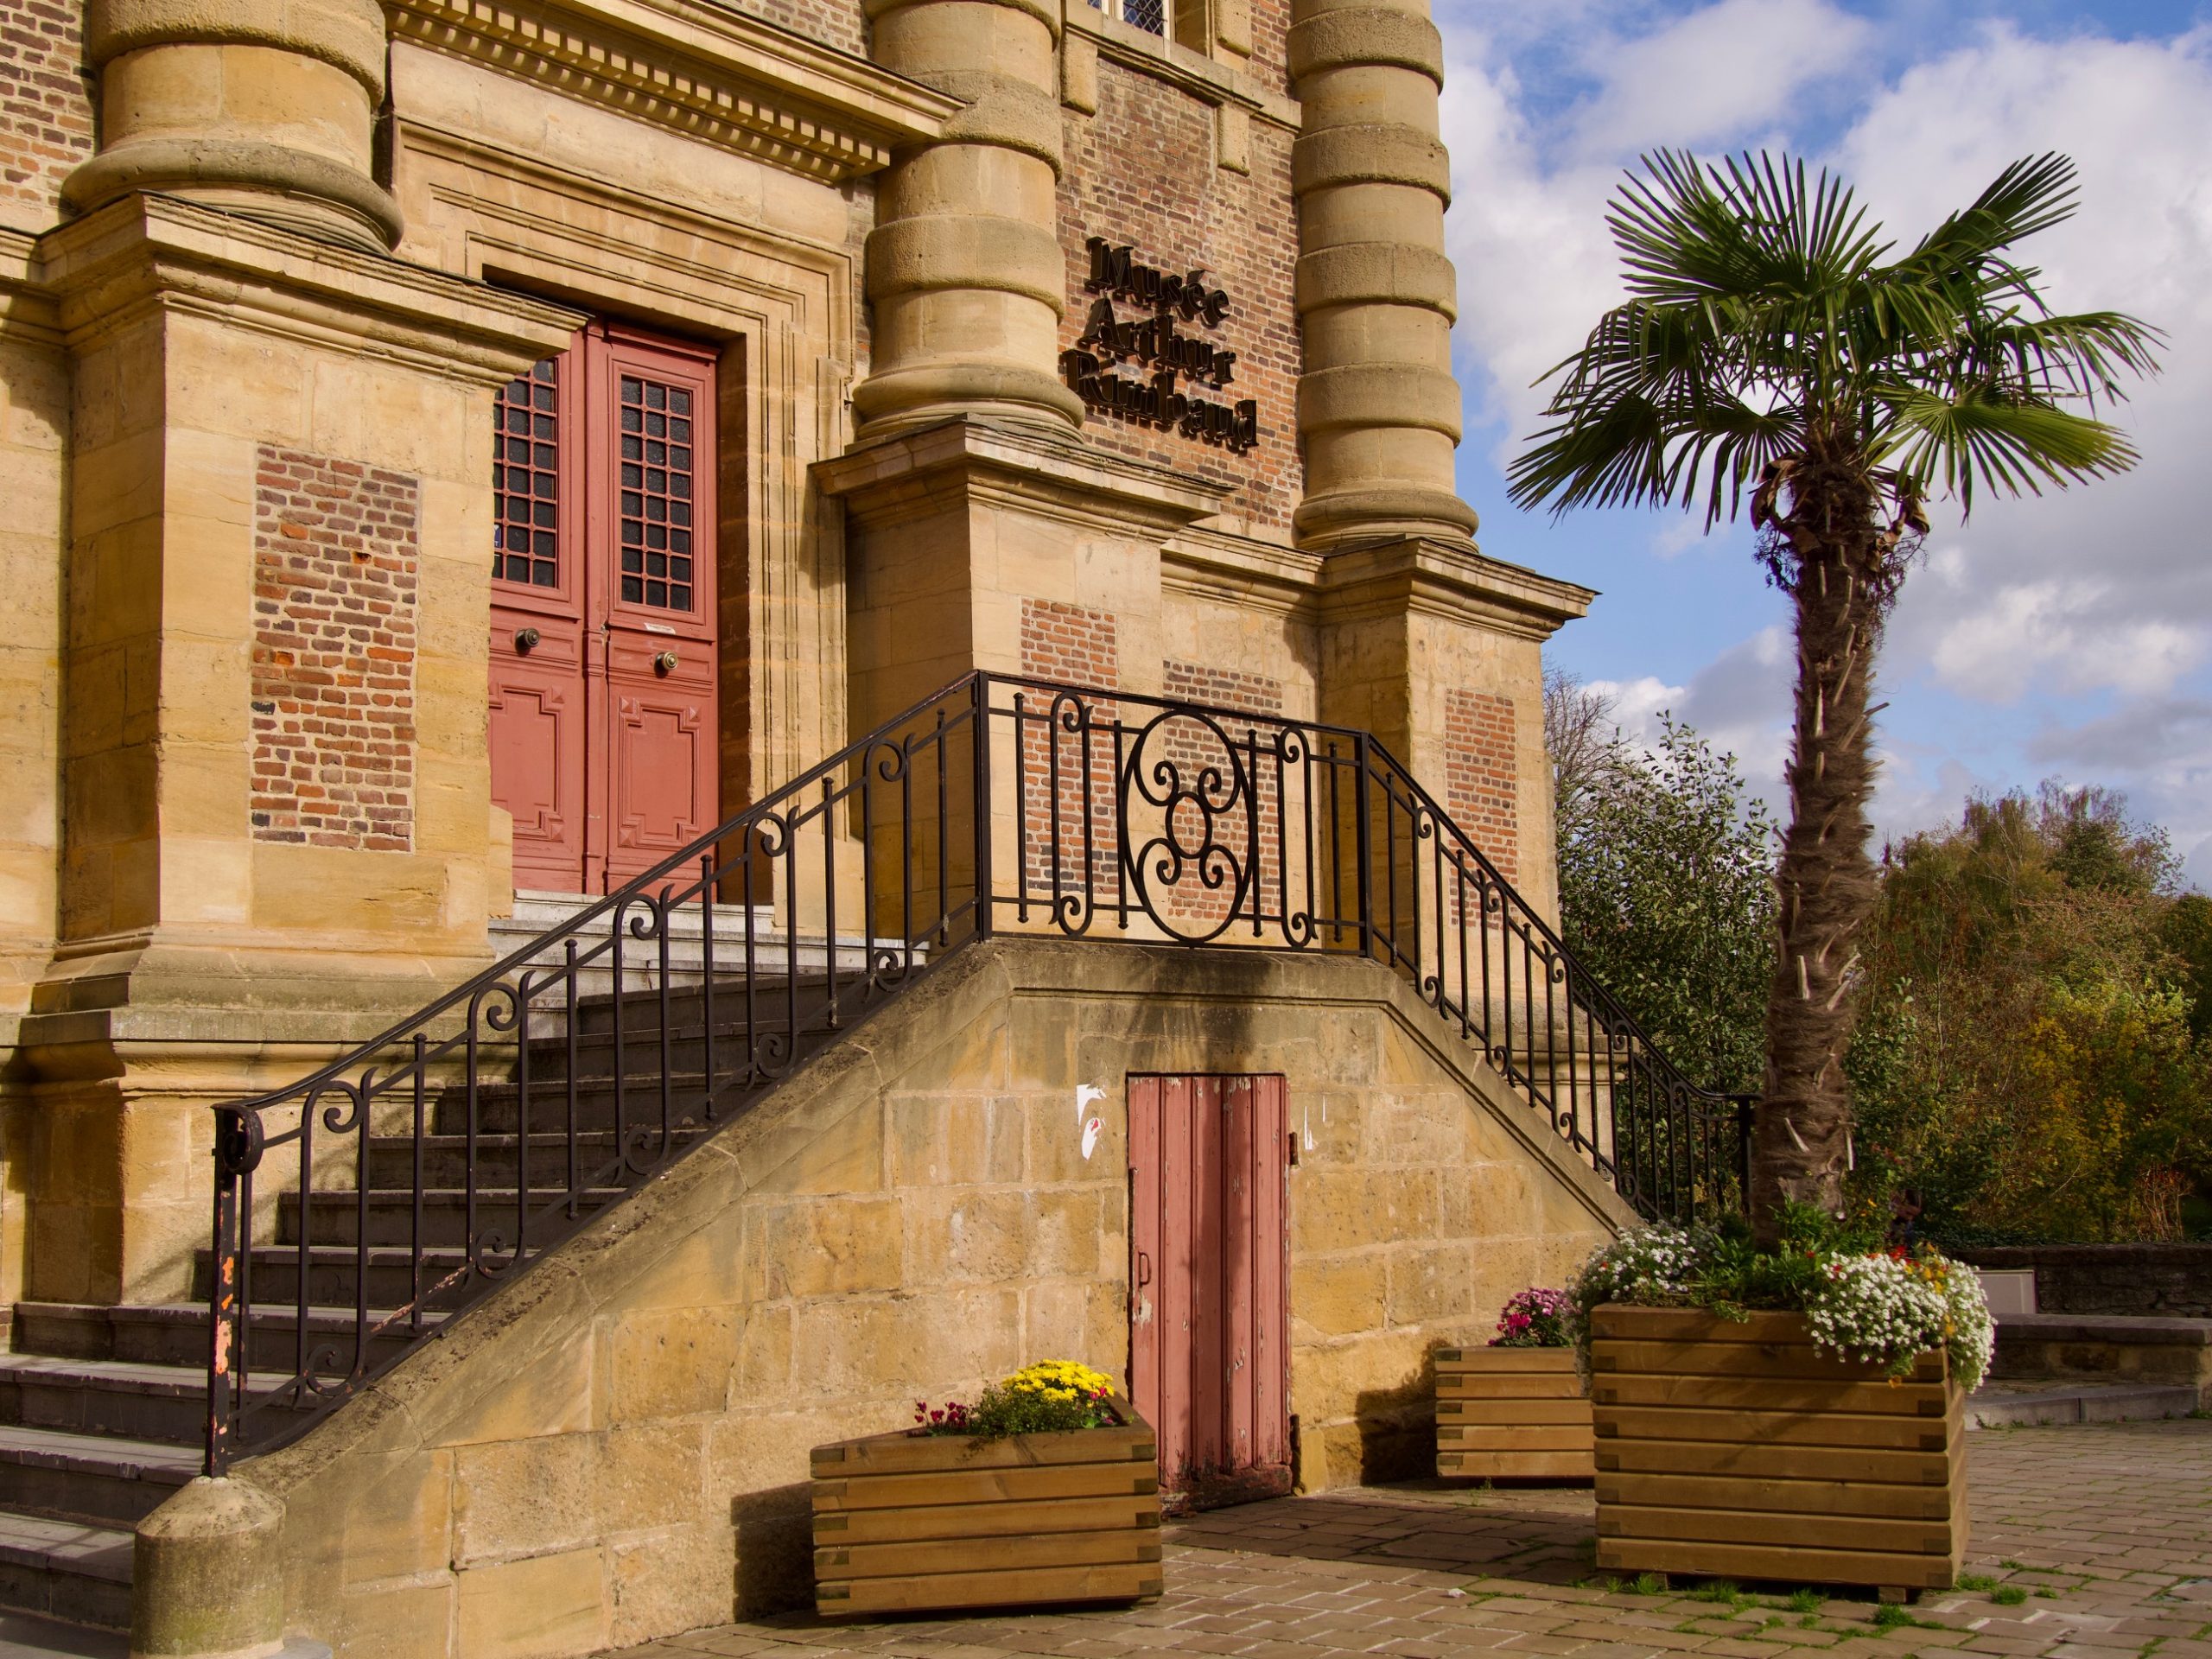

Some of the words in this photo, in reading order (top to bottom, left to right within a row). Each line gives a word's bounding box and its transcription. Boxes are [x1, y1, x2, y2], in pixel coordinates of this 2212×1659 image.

[1085, 237, 1230, 323] Musée
[1080, 297, 1236, 385] Arthur
[1061, 349, 1259, 448] Rimbaud
